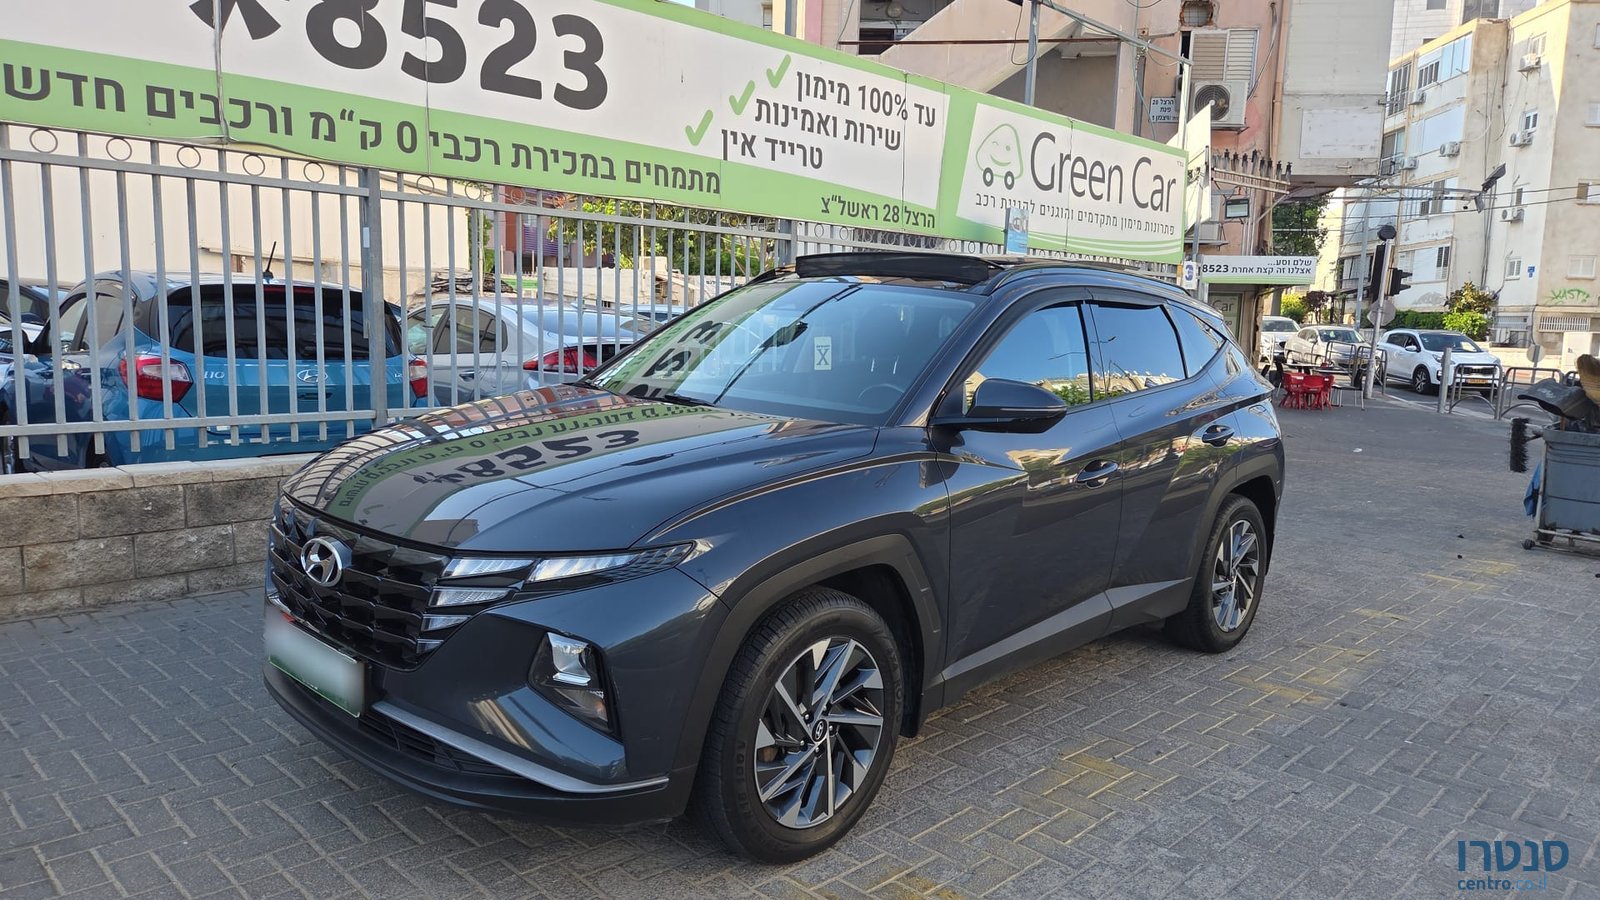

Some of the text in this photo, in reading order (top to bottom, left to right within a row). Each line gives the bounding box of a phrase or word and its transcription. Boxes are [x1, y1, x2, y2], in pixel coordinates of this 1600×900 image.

[796, 71, 936, 127] עד 100% מימון
[3, 63, 720, 194] מתמחים במכירת רכבי 0 ק"מ ורכבים חדש
[755, 98, 900, 150] שירות ואמינות
[721, 129, 823, 169] טרייד אין
[1030, 131, 1177, 213] Green Car
[975, 193, 996, 208] רכב
[821, 194, 935, 228] הרצל 28 ראשל"צ
[1040, 204, 1073, 220] והוגנים
[1077, 210, 1117, 228] מתקדמים
[1121, 217, 1142, 230] מימון
[1144, 221, 1174, 235] פתרונות
[1202, 264, 1229, 273] 8523
[1293, 258, 1312, 266] שלם
[1256, 267, 1274, 275] קצת
